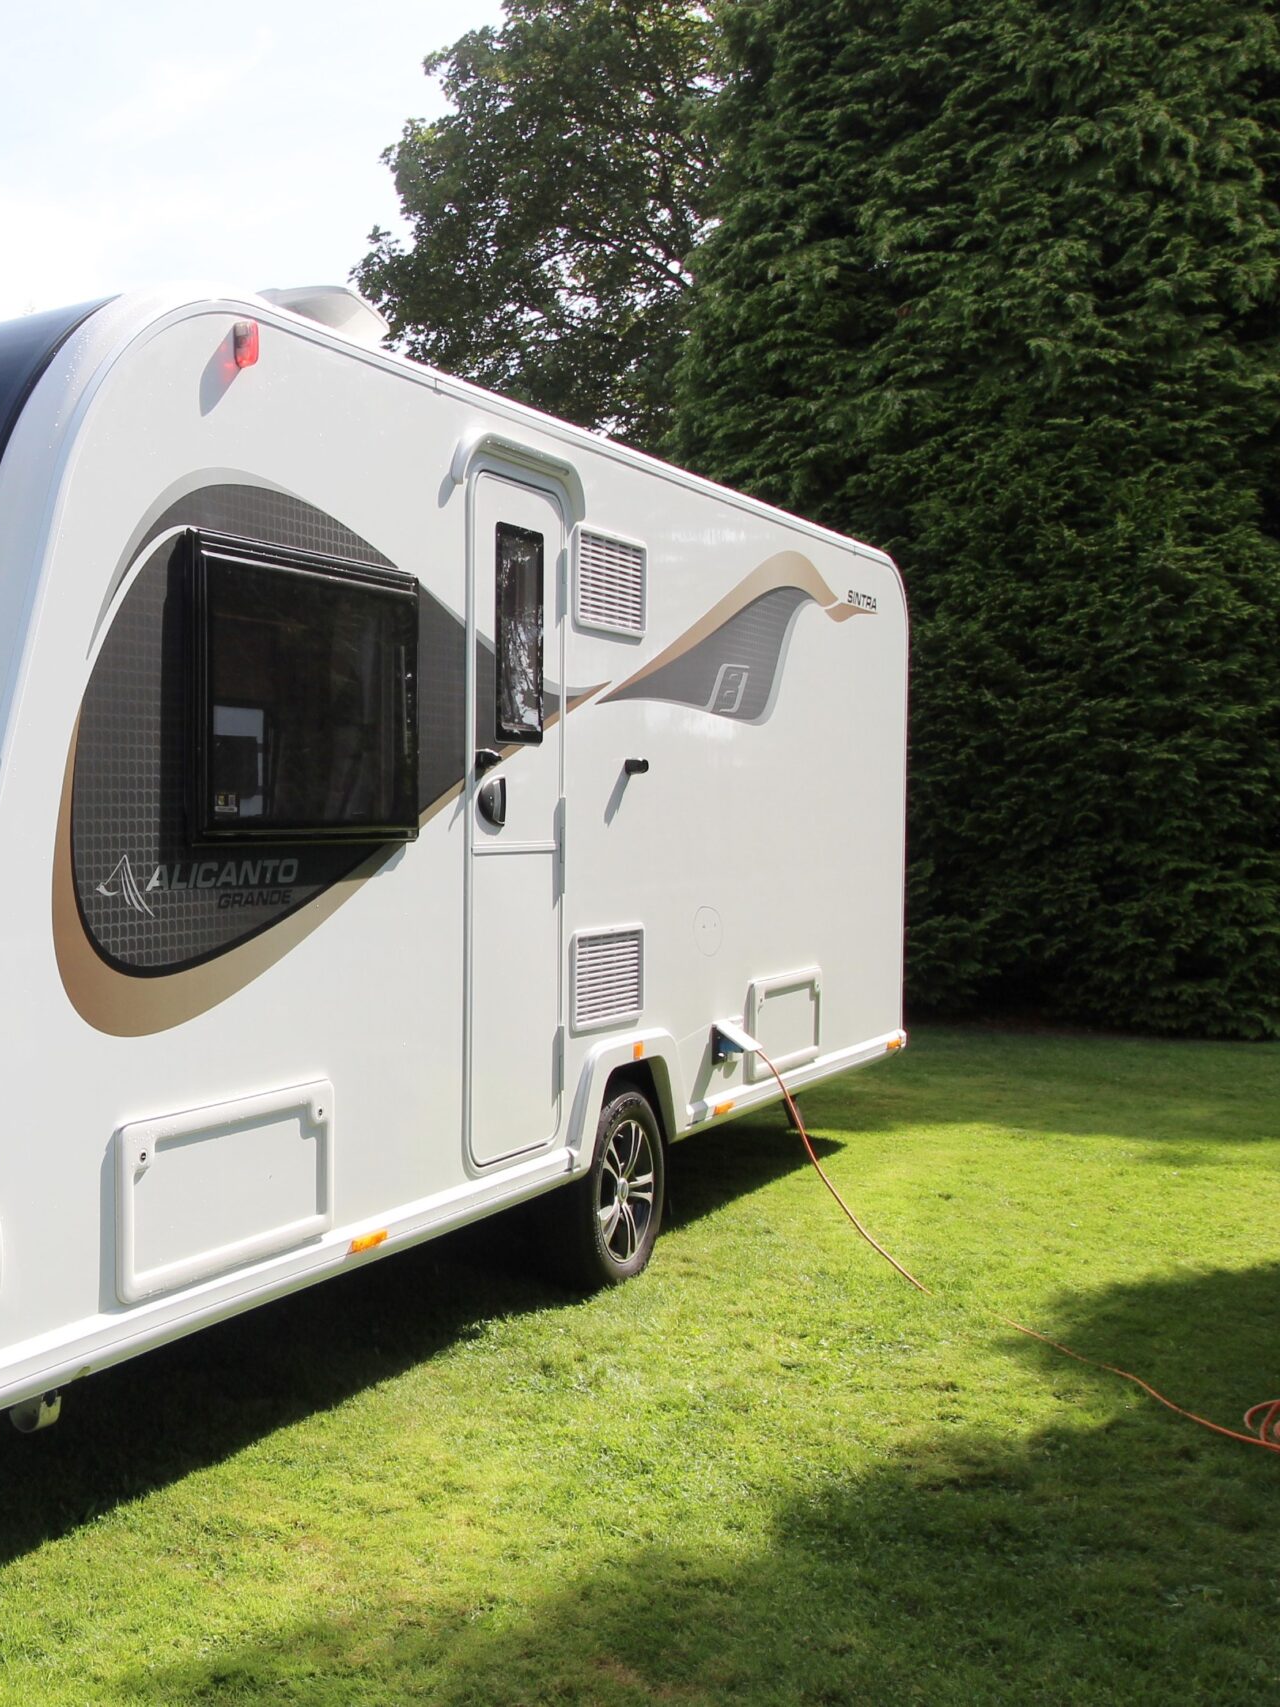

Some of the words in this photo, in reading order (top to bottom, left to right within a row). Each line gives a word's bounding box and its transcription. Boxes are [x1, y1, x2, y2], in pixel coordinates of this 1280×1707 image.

[847, 590, 877, 611] SINTRA
[145, 858, 298, 892] ALICANTO
[218, 889, 292, 909] GRANDE
